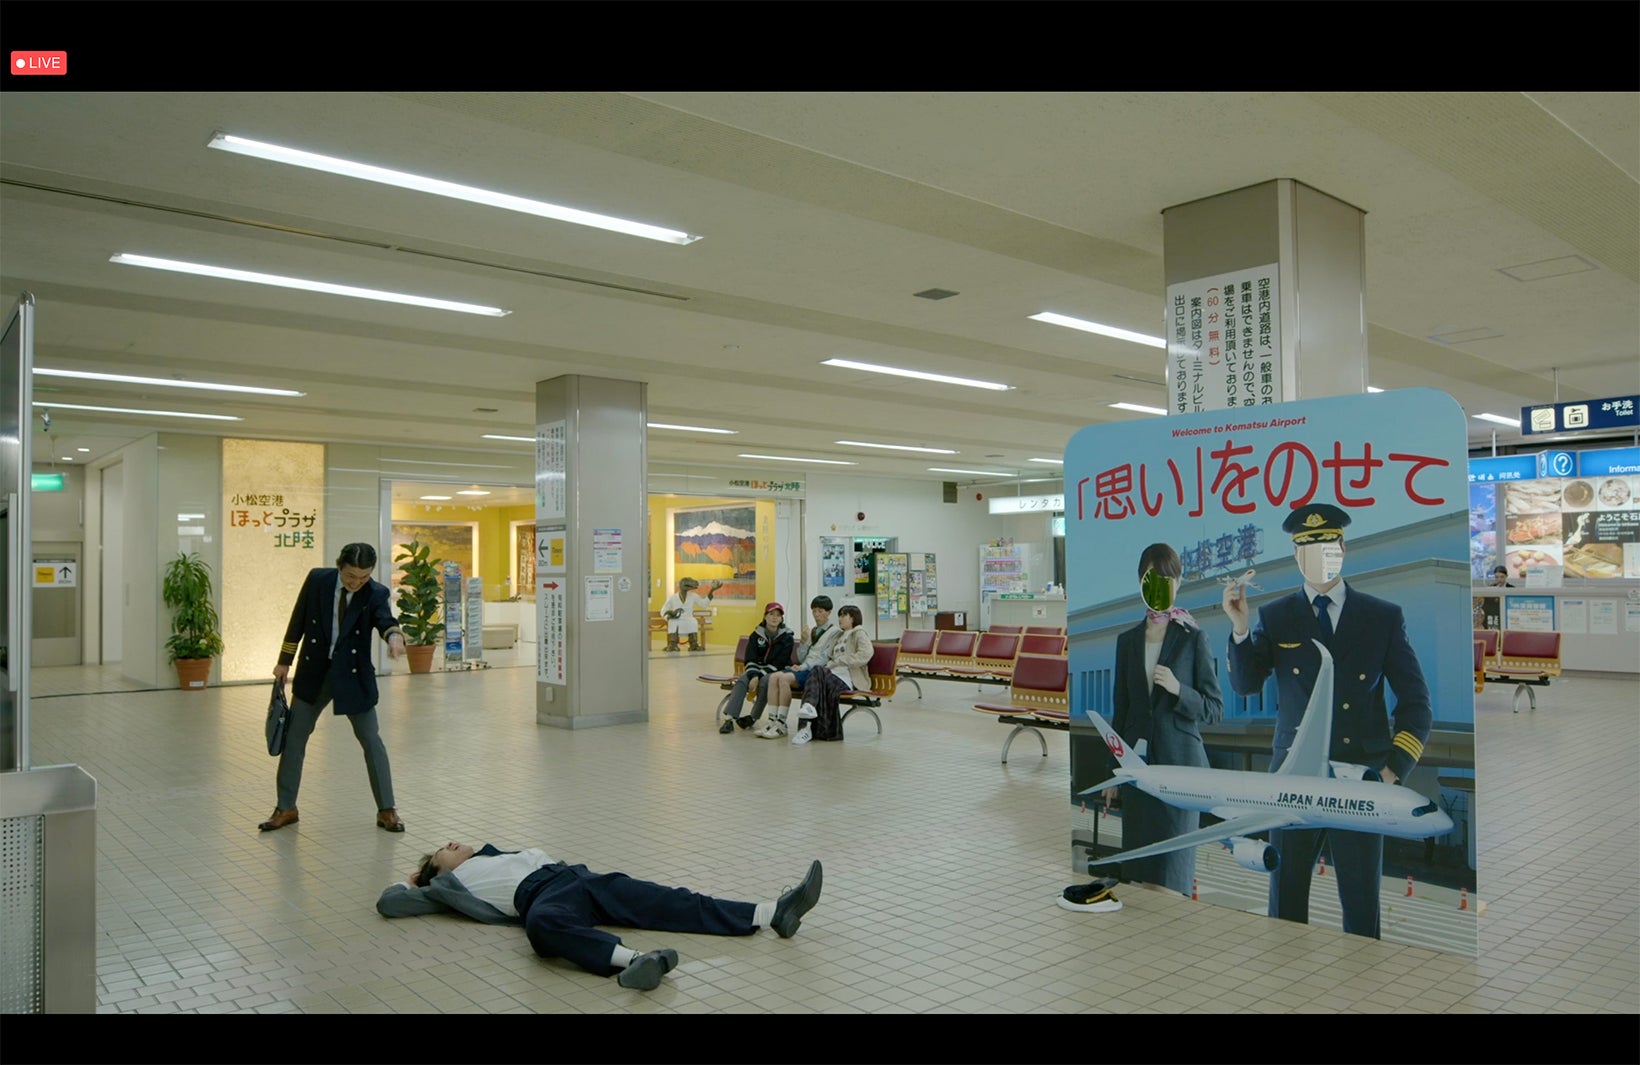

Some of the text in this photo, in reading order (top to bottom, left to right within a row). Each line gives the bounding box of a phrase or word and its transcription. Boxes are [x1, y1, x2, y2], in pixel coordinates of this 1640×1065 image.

[1601, 400, 1634, 412] お手洗
[1172, 416, 1306, 438] Welcome to Komatsu Airport
[1077, 439, 1450, 520] 「思い」をのせて
[231, 494, 284, 506] 小松空港
[231, 508, 316, 528] ほっとプラザ
[1600, 512, 1640, 521] ようこそ石
[274, 530, 315, 549] 北陸
[1277, 792, 1375, 812] JAPAN AIRLINES
